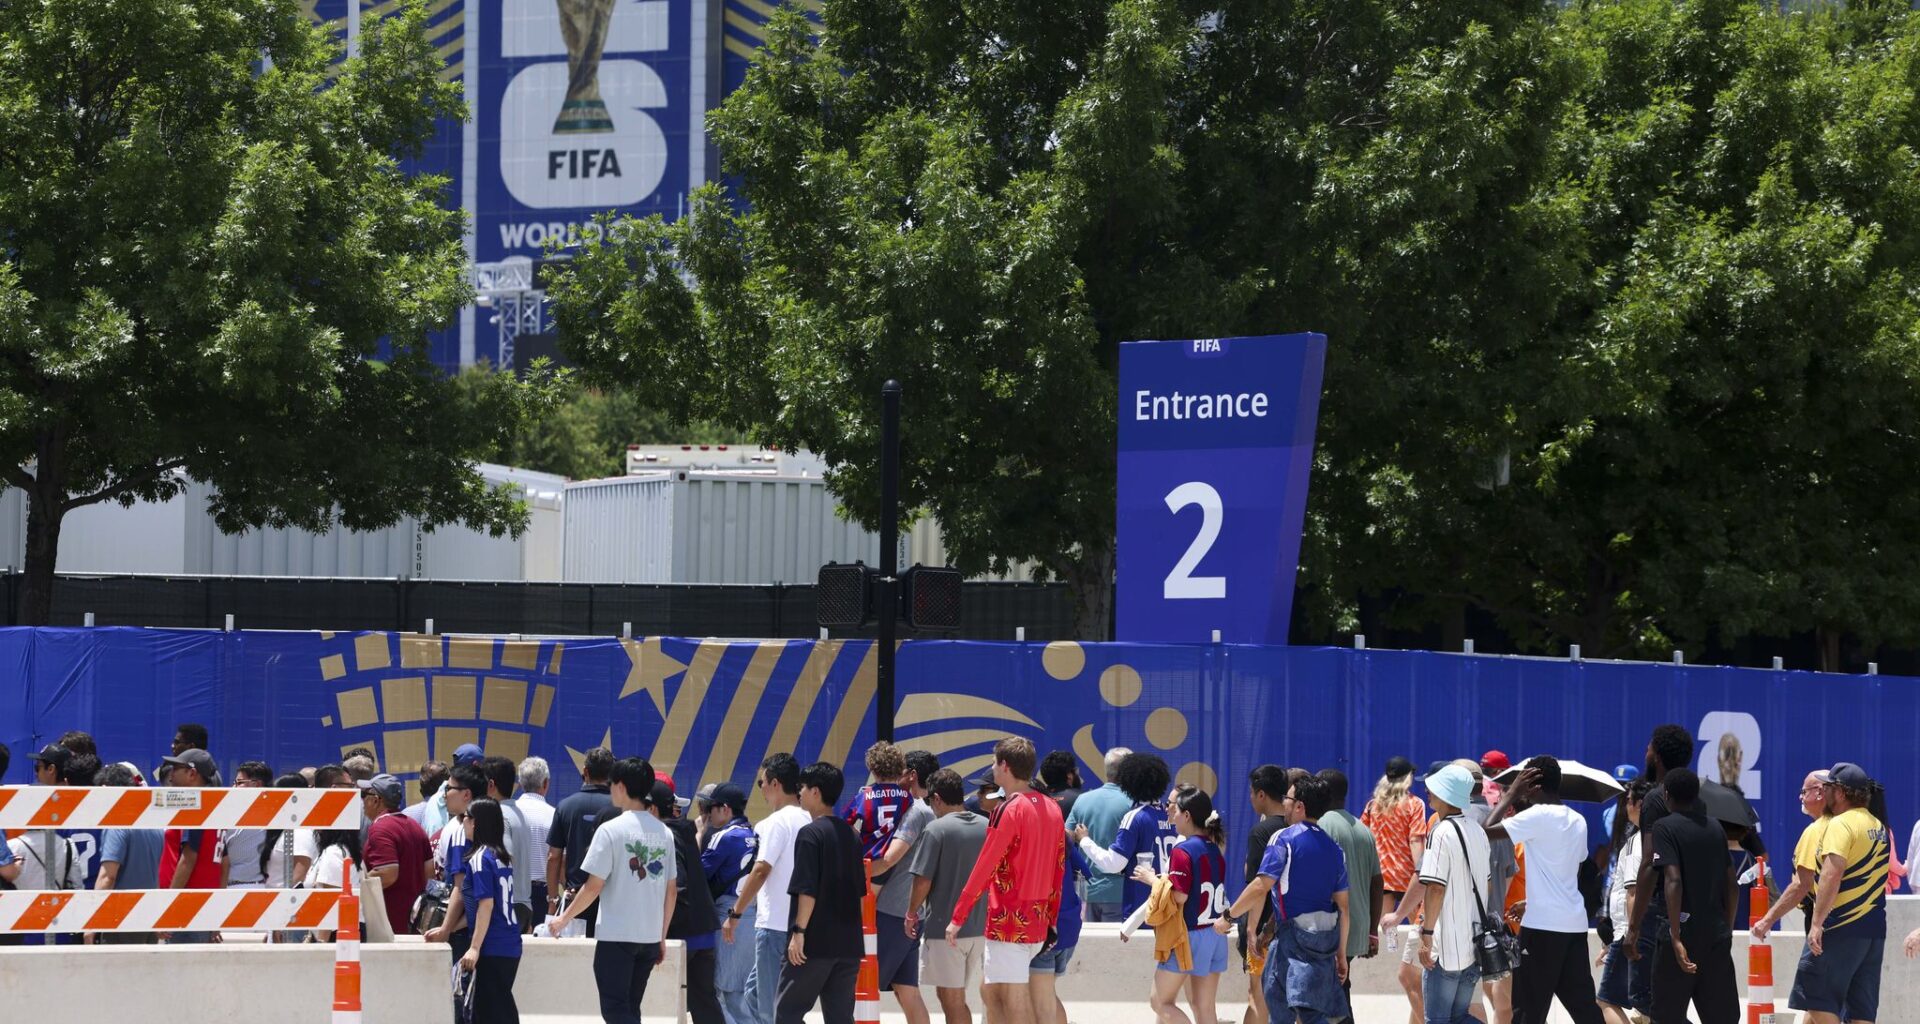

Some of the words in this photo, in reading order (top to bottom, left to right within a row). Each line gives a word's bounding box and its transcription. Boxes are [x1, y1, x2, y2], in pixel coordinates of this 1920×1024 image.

[548, 149, 622, 180] FIFA
[1193, 339, 1221, 353] FIFA
[1136, 390, 1269, 421] Entrance
[1164, 481, 1226, 599] 2
[865, 789, 908, 800] NAGATOMO
[873, 805, 898, 838] 5
